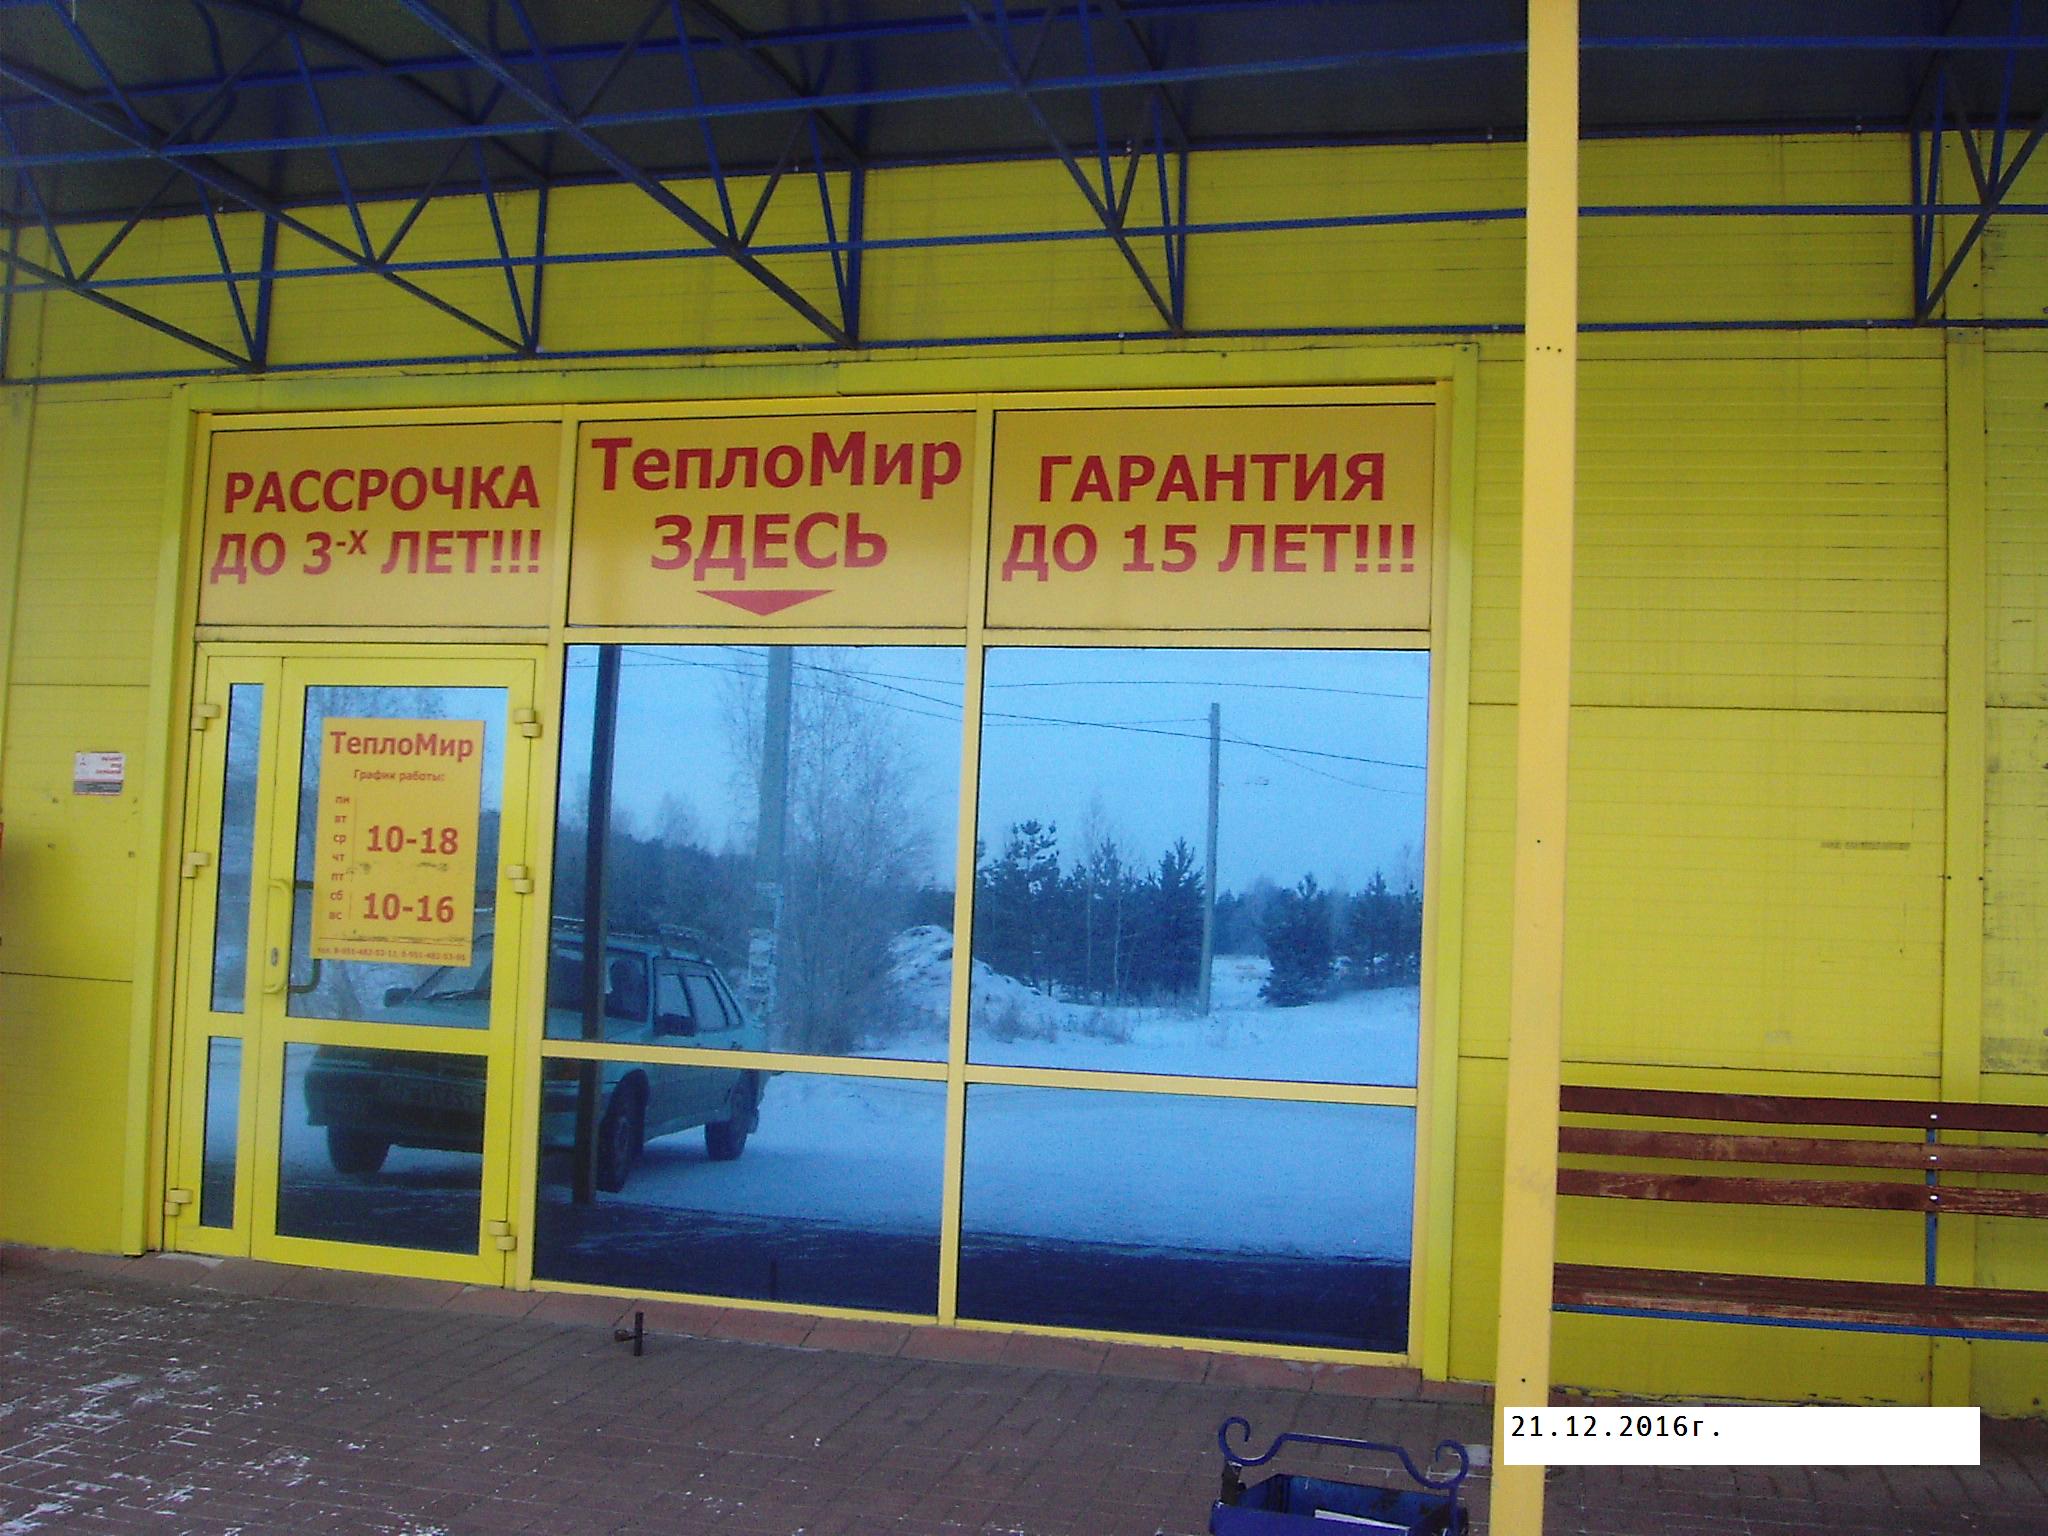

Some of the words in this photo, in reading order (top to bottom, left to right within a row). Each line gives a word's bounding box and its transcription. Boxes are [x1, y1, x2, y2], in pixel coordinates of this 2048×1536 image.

[591, 431, 963, 500] ТеплоМир
[1039, 452, 1386, 503] ГАРАНТИЯ
[224, 465, 541, 513] РАССРОЧКА
[209, 532, 287, 585] ДО
[380, 528, 542, 575] ЛЕТ!!!
[650, 511, 888, 582] ЗДЕСЬ
[1001, 523, 1098, 583] ДО
[1121, 523, 1198, 573] 15
[1217, 523, 1417, 573] ЛЕТ!!!
[329, 730, 475, 763] ТеплоМир
[352, 768, 396, 782] График
[333, 834, 347, 845] ср
[366, 824, 459, 855] 10-18
[329, 889, 344, 901] сб
[363, 892, 455, 924] 10-16
